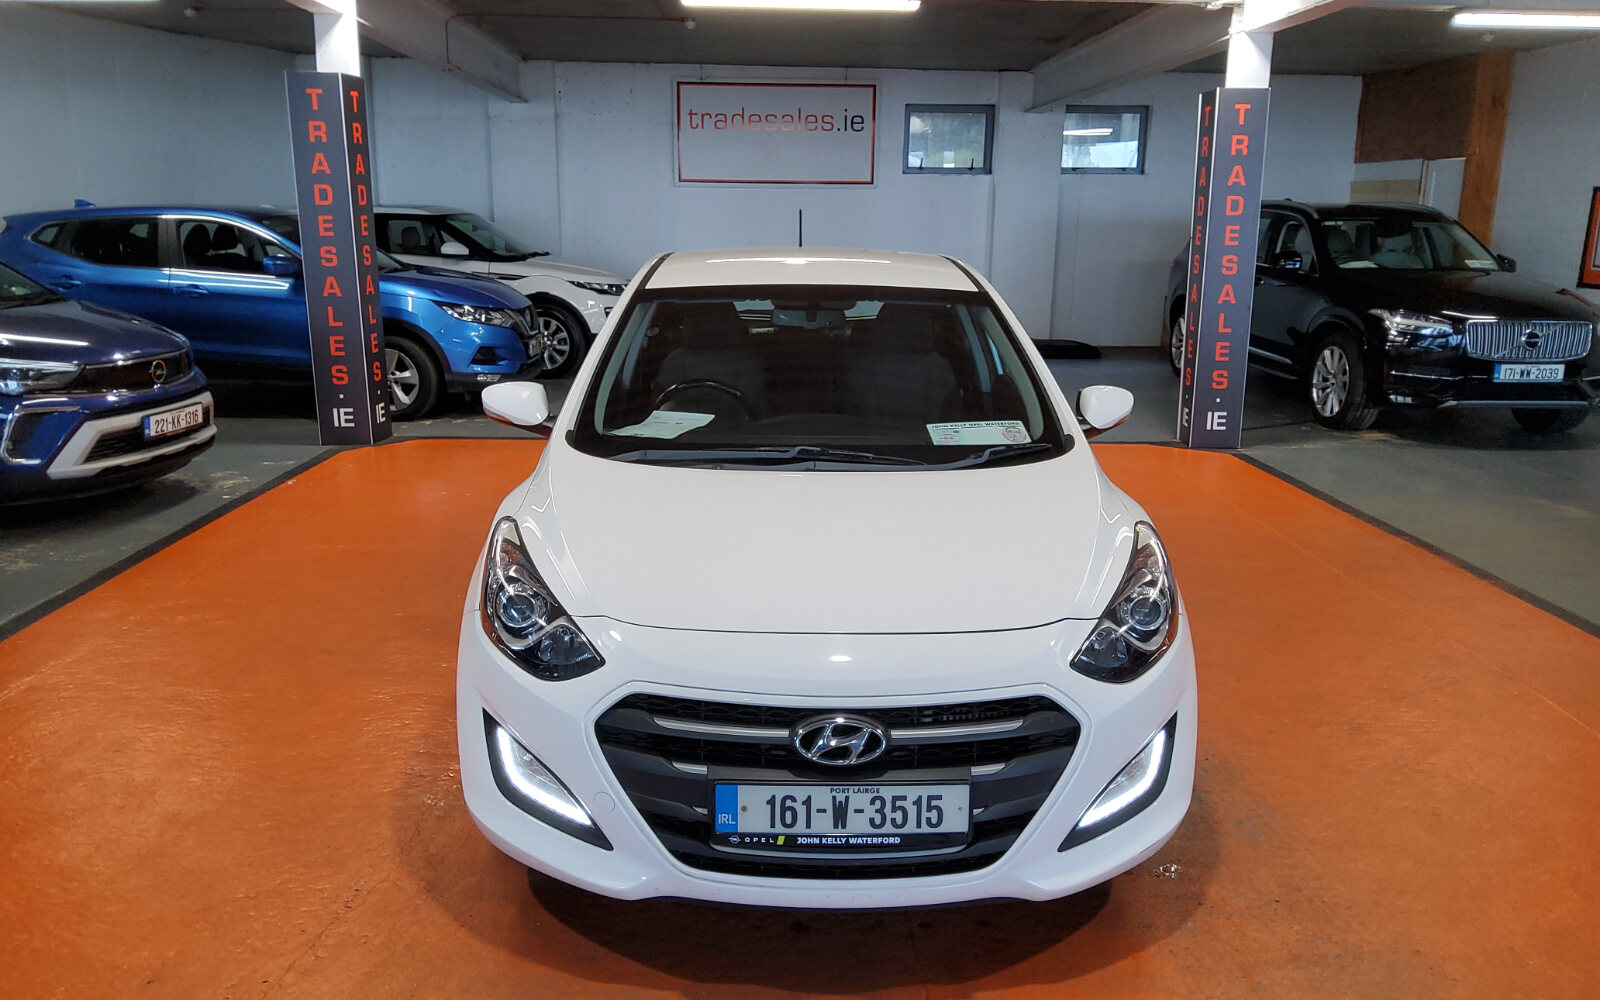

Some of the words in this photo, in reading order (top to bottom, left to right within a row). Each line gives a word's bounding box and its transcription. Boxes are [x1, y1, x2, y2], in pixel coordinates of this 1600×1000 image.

[688, 107, 865, 132] tradesales.ie
[154, 409, 199, 434] 221-KK-1316
[718, 813, 736, 825] IRL
[766, 795, 943, 829] 161-W-3515
